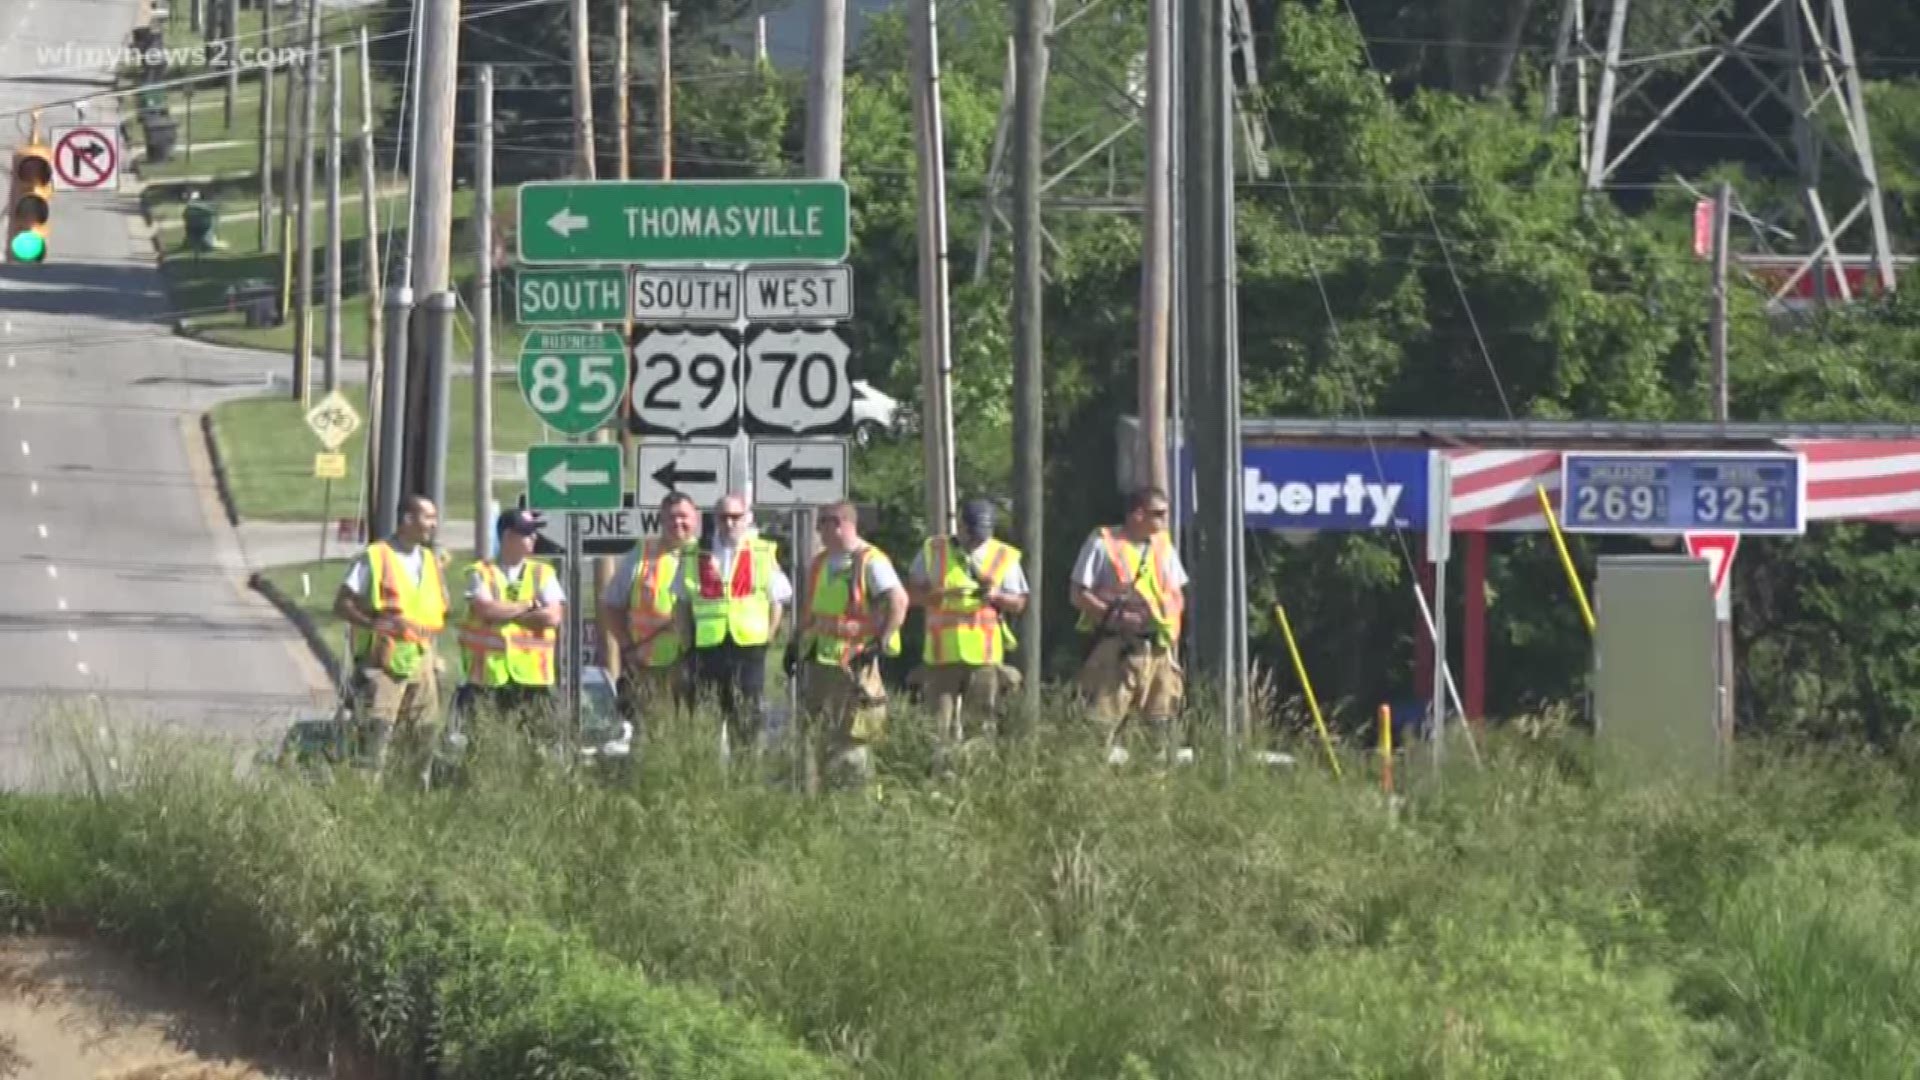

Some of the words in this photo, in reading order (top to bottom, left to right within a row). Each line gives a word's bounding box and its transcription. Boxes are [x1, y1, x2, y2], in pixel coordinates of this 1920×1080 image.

[623, 206, 823, 237] THOMASVILLE
[522, 281, 621, 312] SOUTH
[638, 280, 732, 309] SOUTH
[759, 278, 837, 307] WEST
[530, 356, 616, 413] 85
[644, 353, 726, 411] 29
[760, 353, 838, 410] 70
[1244, 467, 1403, 527] berty
[1578, 486, 1654, 521] 269
[1697, 486, 1770, 522] 325
